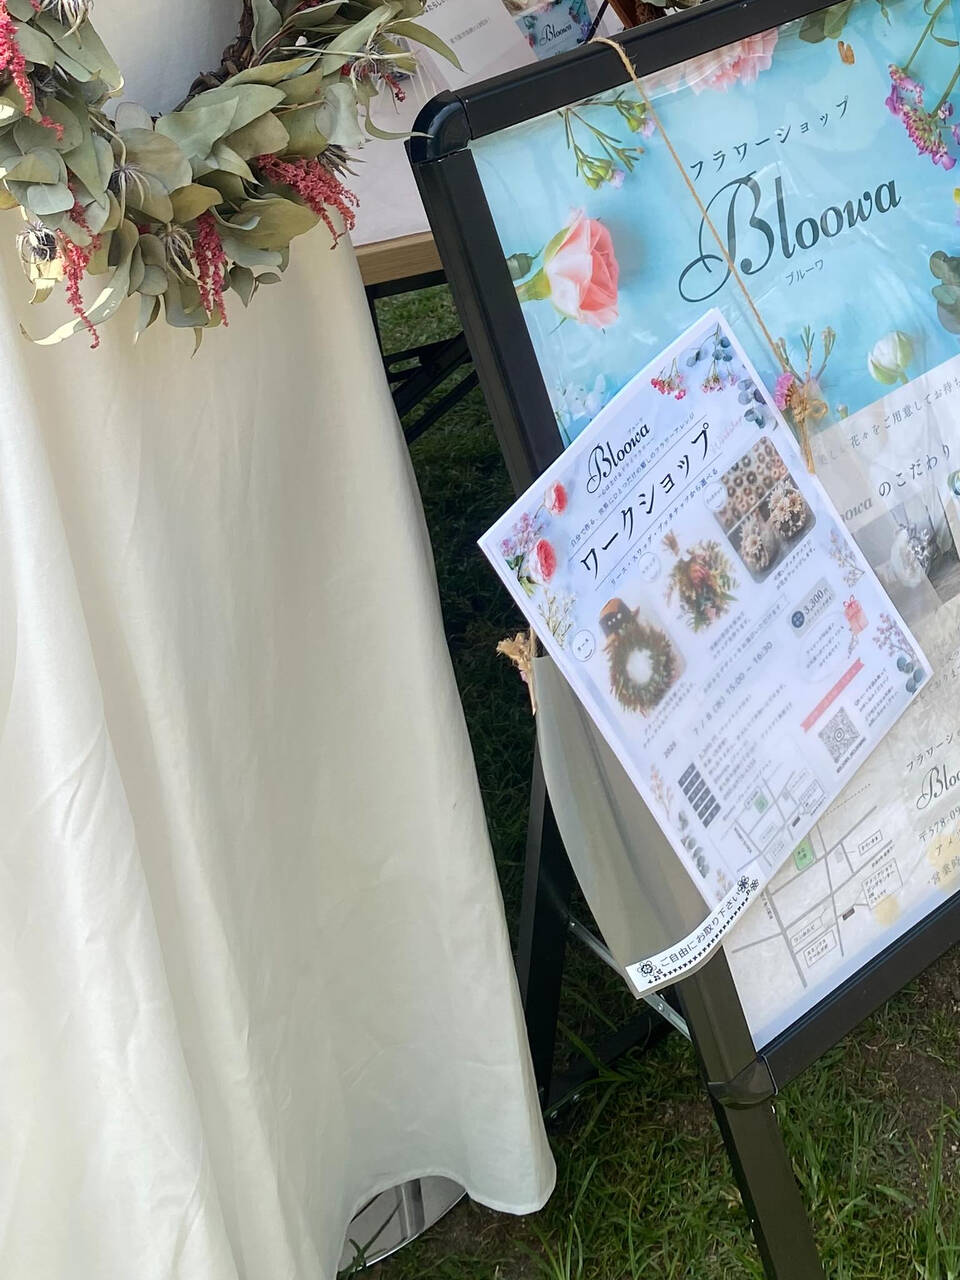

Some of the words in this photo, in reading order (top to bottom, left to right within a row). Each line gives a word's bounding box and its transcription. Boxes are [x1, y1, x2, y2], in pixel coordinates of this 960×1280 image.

[687, 95, 854, 182] フラワーショップ
[677, 171, 902, 303] Bloowa
[784, 256, 826, 288] ブルーワ
[583, 420, 652, 496] Bloowa
[877, 441, 951, 499] のこだわり
[580, 420, 720, 581] ワークショップ
[658, 889, 742, 968] ご自由にお取り下さい
